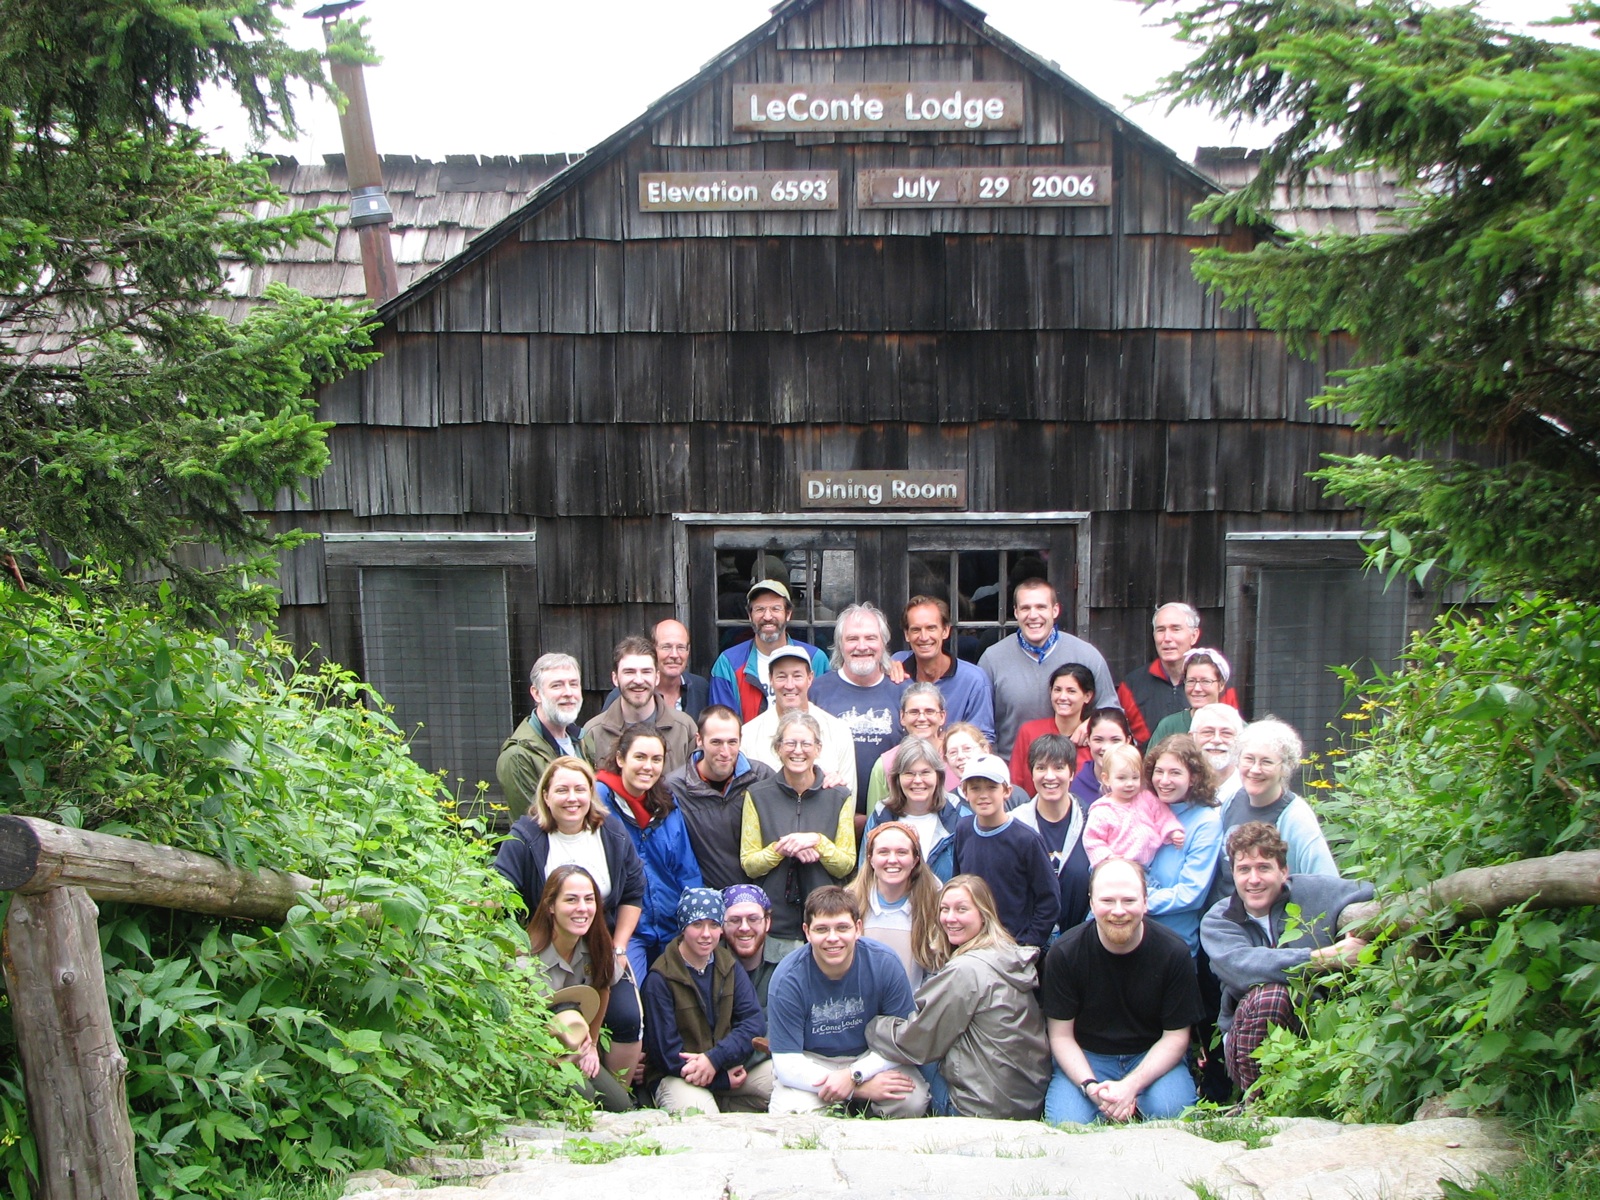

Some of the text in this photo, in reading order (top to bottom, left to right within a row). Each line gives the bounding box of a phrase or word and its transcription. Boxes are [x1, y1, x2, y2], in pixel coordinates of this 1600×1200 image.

[750, 90, 1004, 128] LeConte Lodge
[648, 180, 758, 203] Elevation
[893, 175, 1094, 202] July 29 2006
[808, 479, 957, 505] Dining Room
